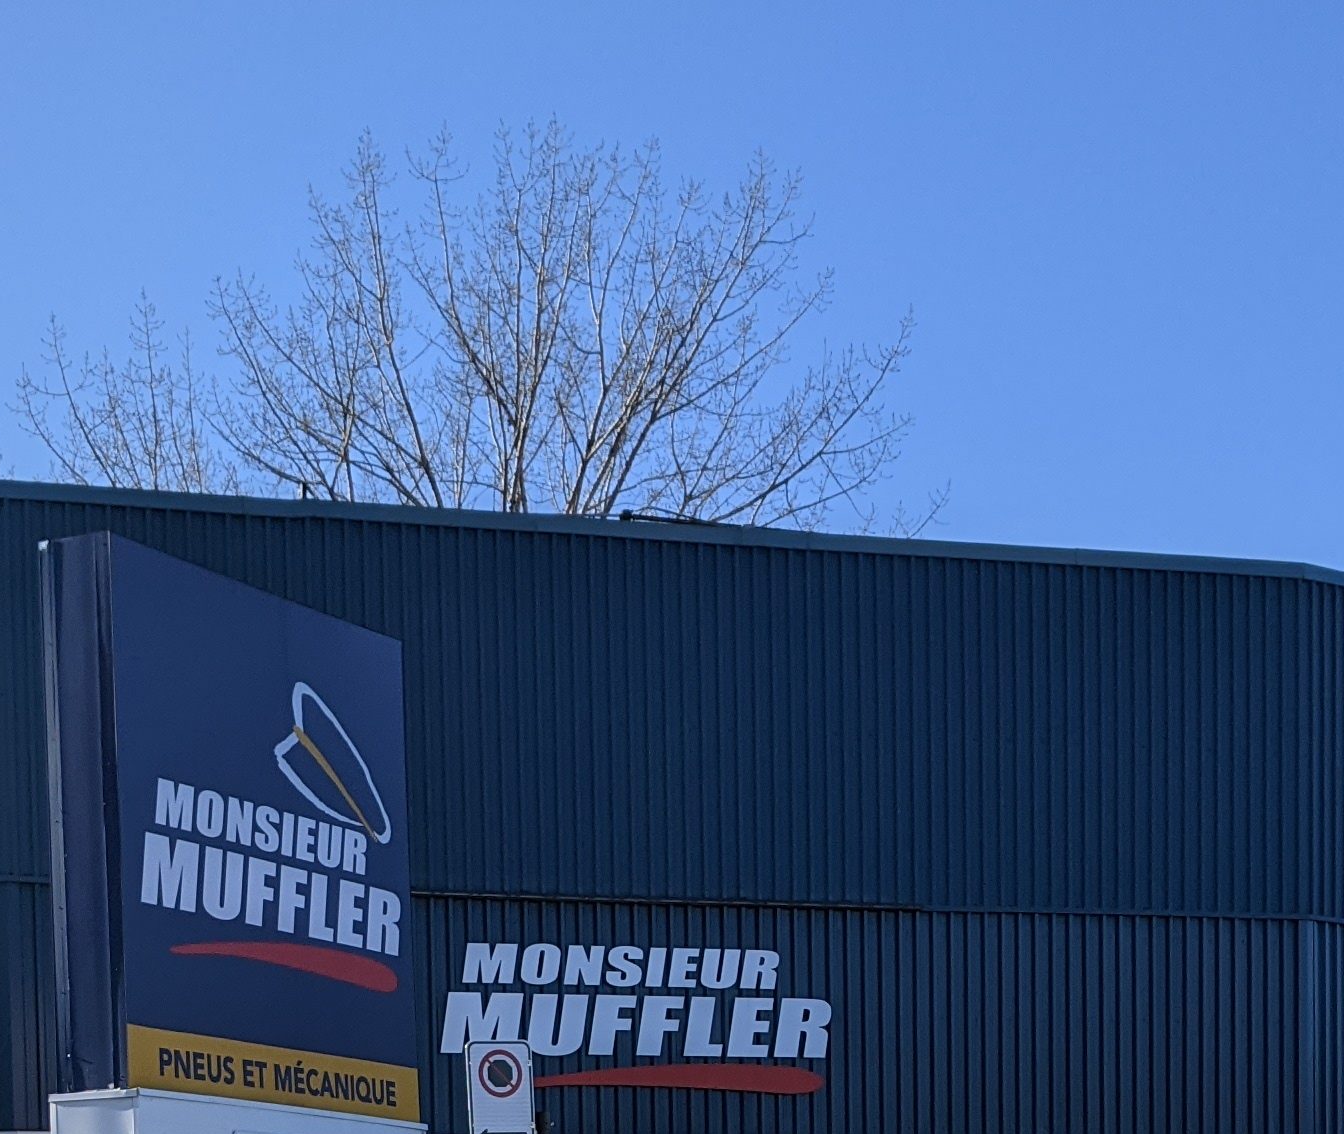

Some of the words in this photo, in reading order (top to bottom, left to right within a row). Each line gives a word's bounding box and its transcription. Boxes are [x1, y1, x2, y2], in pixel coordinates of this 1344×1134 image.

[155, 778, 367, 875] MONSIEUR
[141, 832, 401, 956] MUFFLER
[462, 942, 779, 990] MONSIEUR
[440, 991, 832, 1058] MUFFLER
[159, 1048, 235, 1084] PNEUS
[243, 1060, 267, 1088] ET
[274, 1061, 397, 1107] MÉCANIQUE
